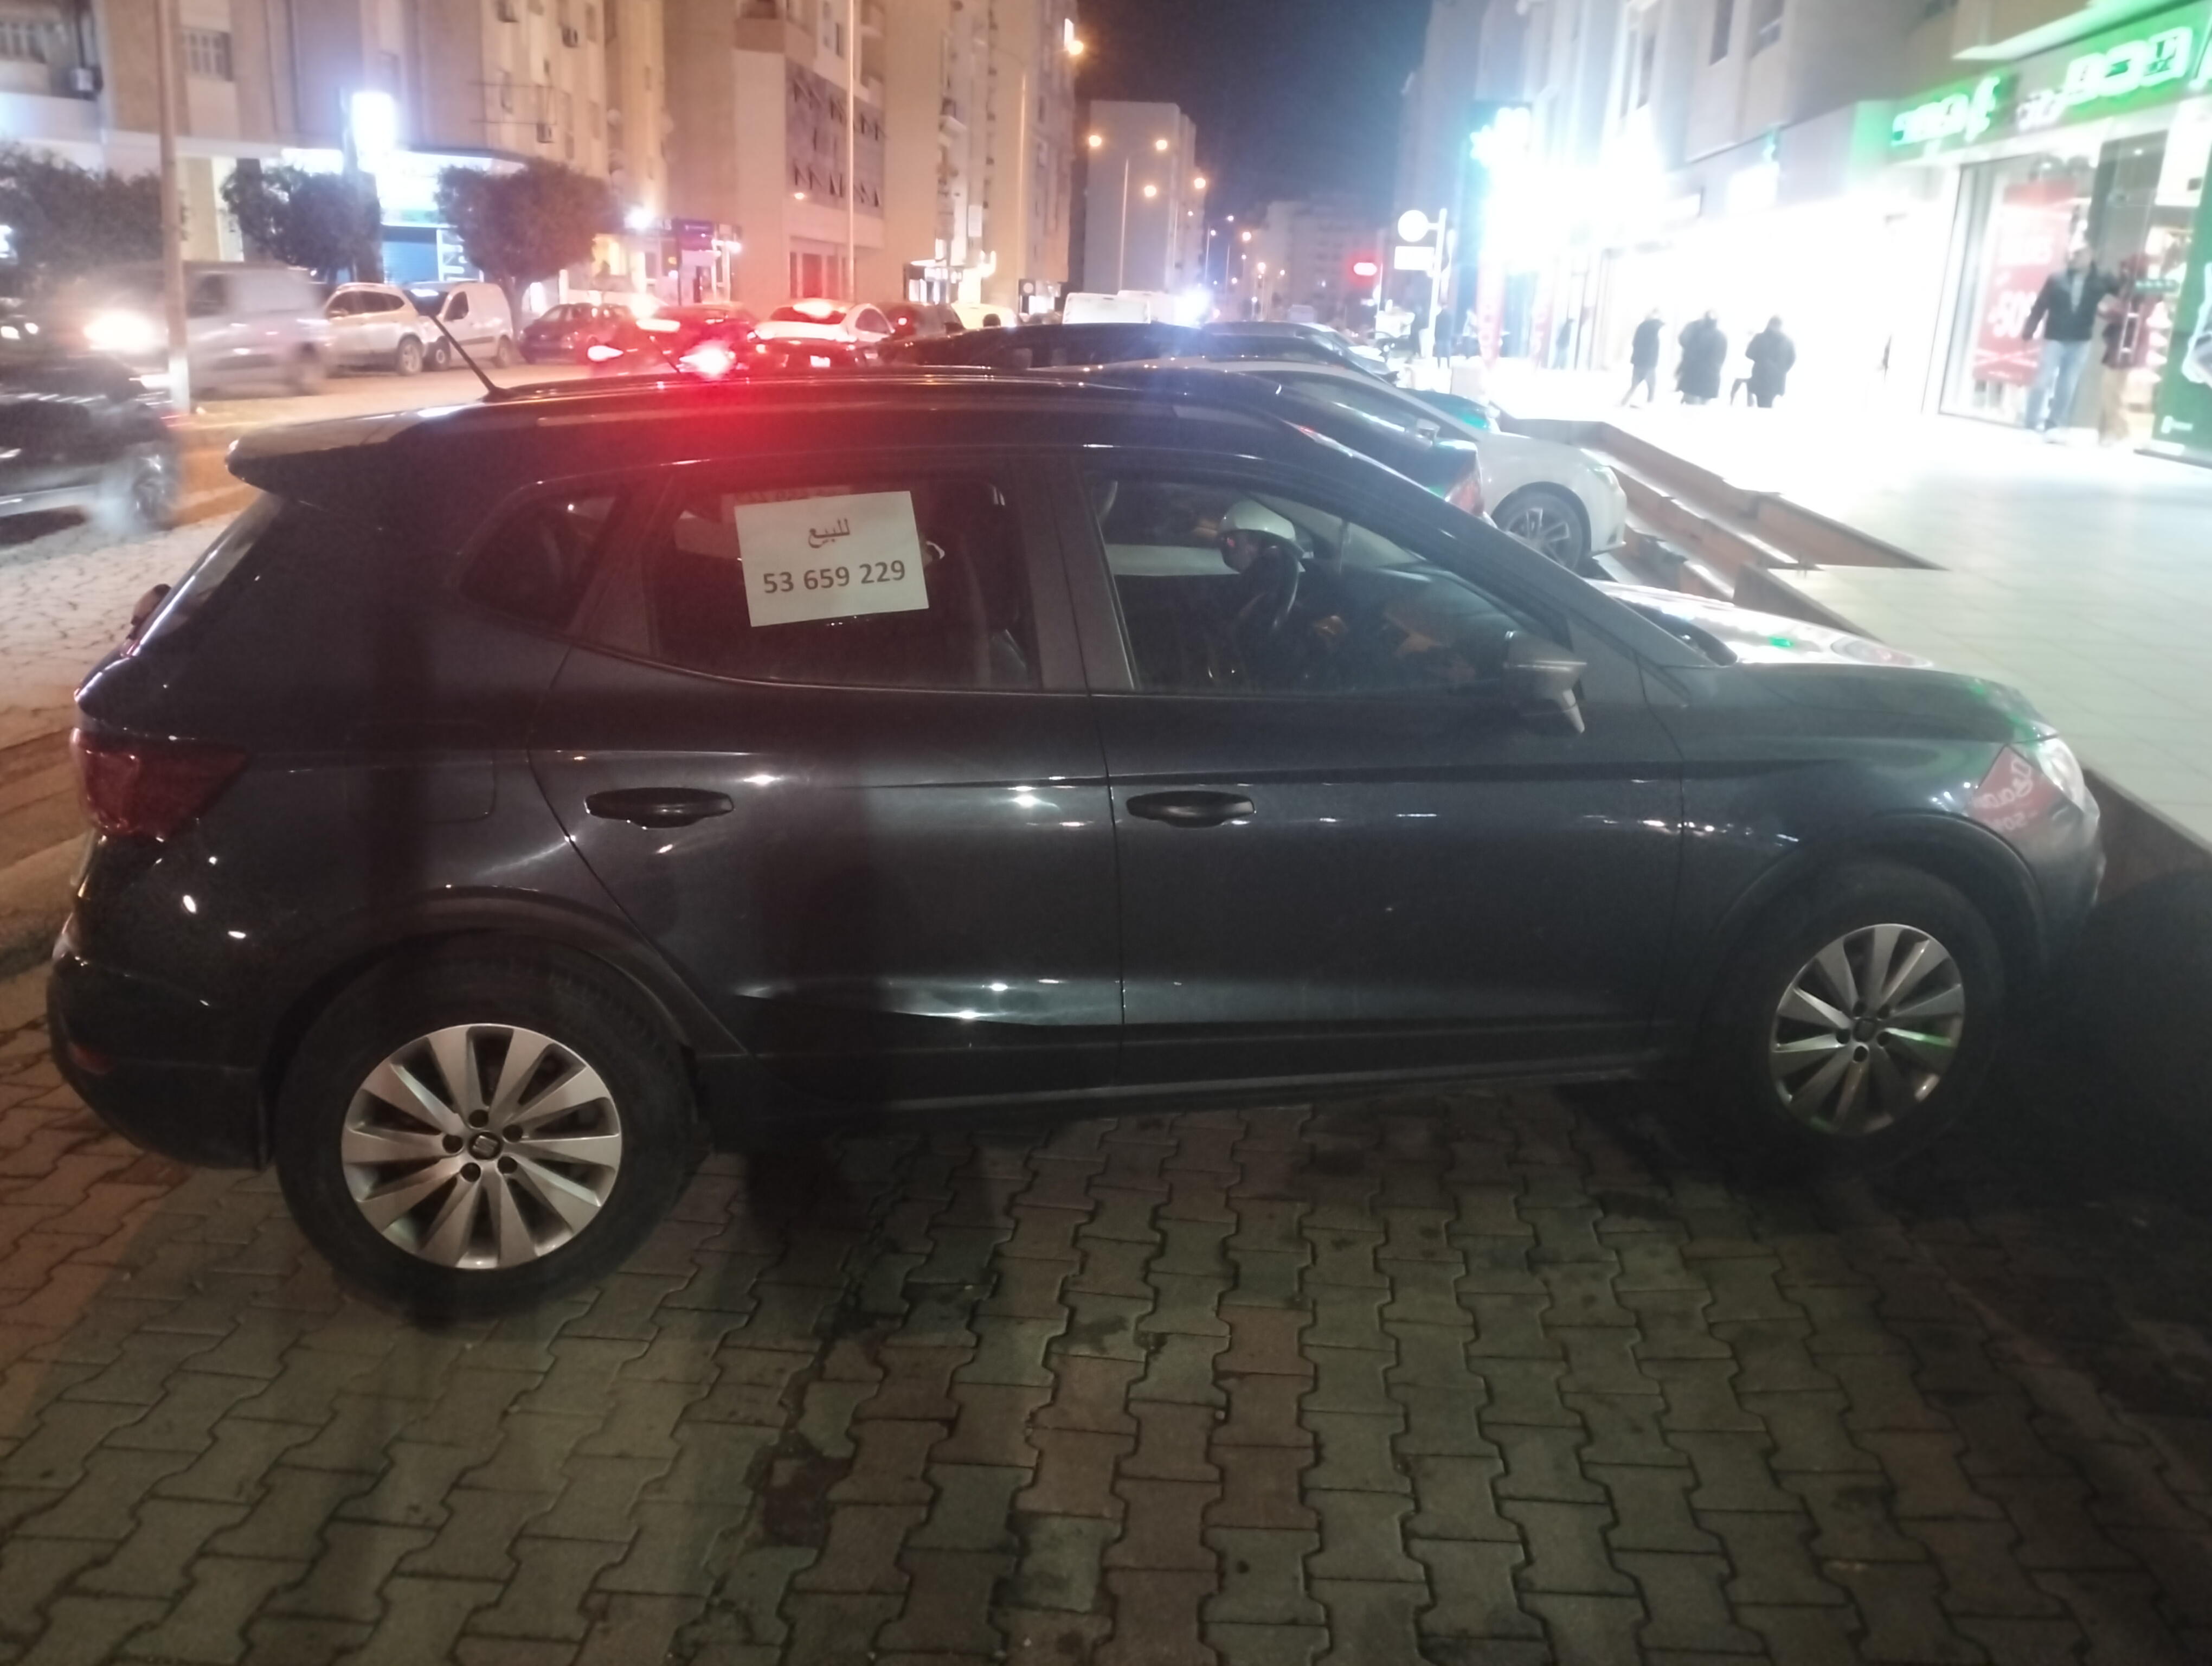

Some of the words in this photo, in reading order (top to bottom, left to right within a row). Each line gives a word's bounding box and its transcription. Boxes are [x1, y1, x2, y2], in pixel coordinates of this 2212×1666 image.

[808, 517, 851, 549] للبيع
[763, 571, 794, 594] 53
[803, 566, 850, 590] 659
[859, 560, 905, 585] 229
